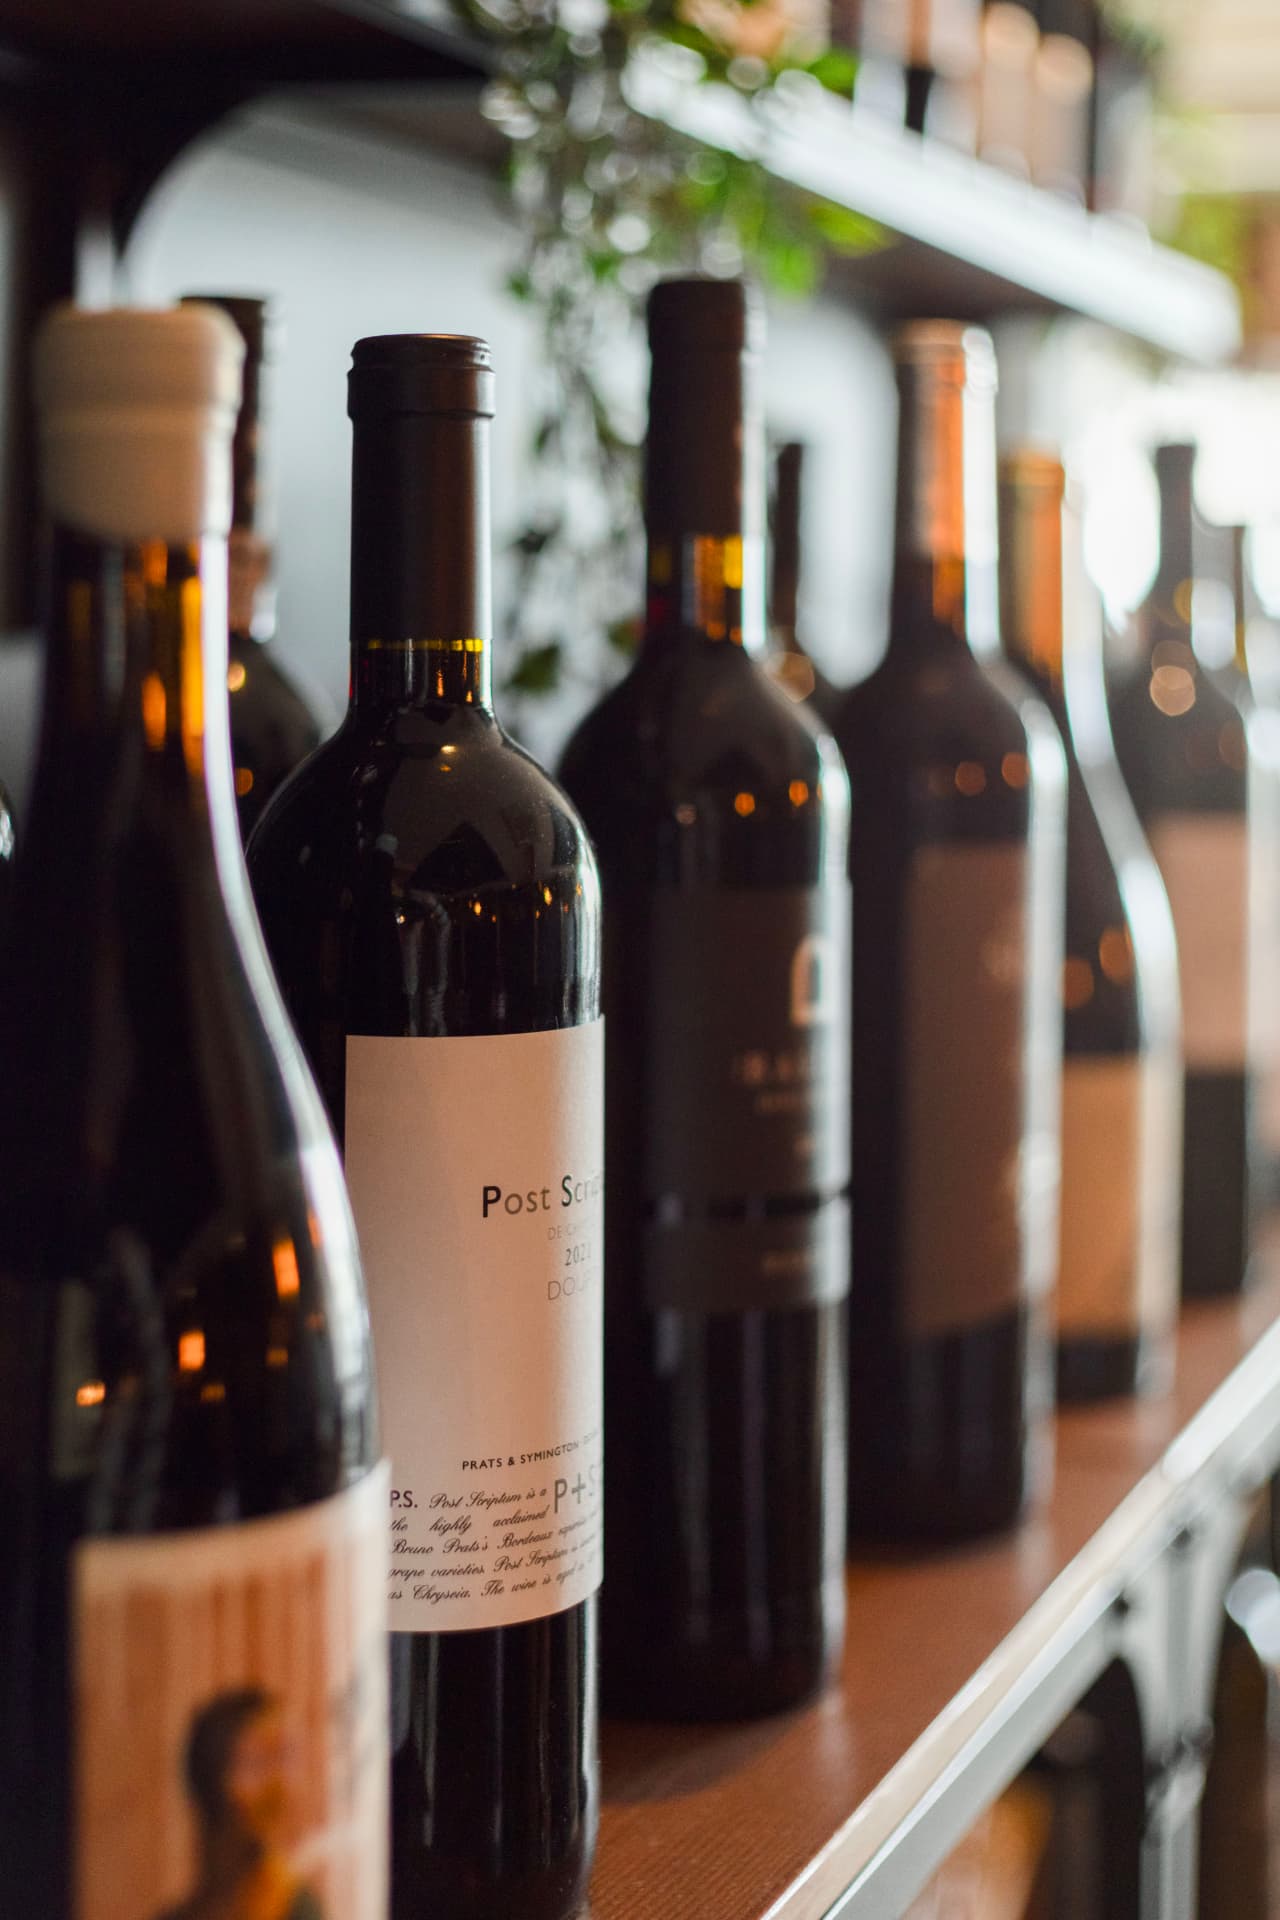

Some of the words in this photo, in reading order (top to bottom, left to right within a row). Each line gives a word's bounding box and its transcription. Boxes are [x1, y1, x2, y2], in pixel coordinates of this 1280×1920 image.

[482, 1185, 551, 1218] Post
[462, 1457, 503, 1471] PRATS
[507, 1456, 516, 1467] &
[520, 1440, 580, 1465] SYMINGTON
[389, 1489, 418, 1509] P.S.
[428, 1493, 464, 1509] Post
[465, 1490, 522, 1511] Scriptum
[390, 1515, 409, 1531] the
[428, 1514, 473, 1537] highly
[492, 1504, 551, 1528] acclaimed
[391, 1538, 434, 1554] Bruno
[496, 1530, 554, 1550] Bordeaux
[493, 1555, 524, 1573] Post
[480, 1579, 504, 1597] The
[511, 1578, 537, 1593] wine
